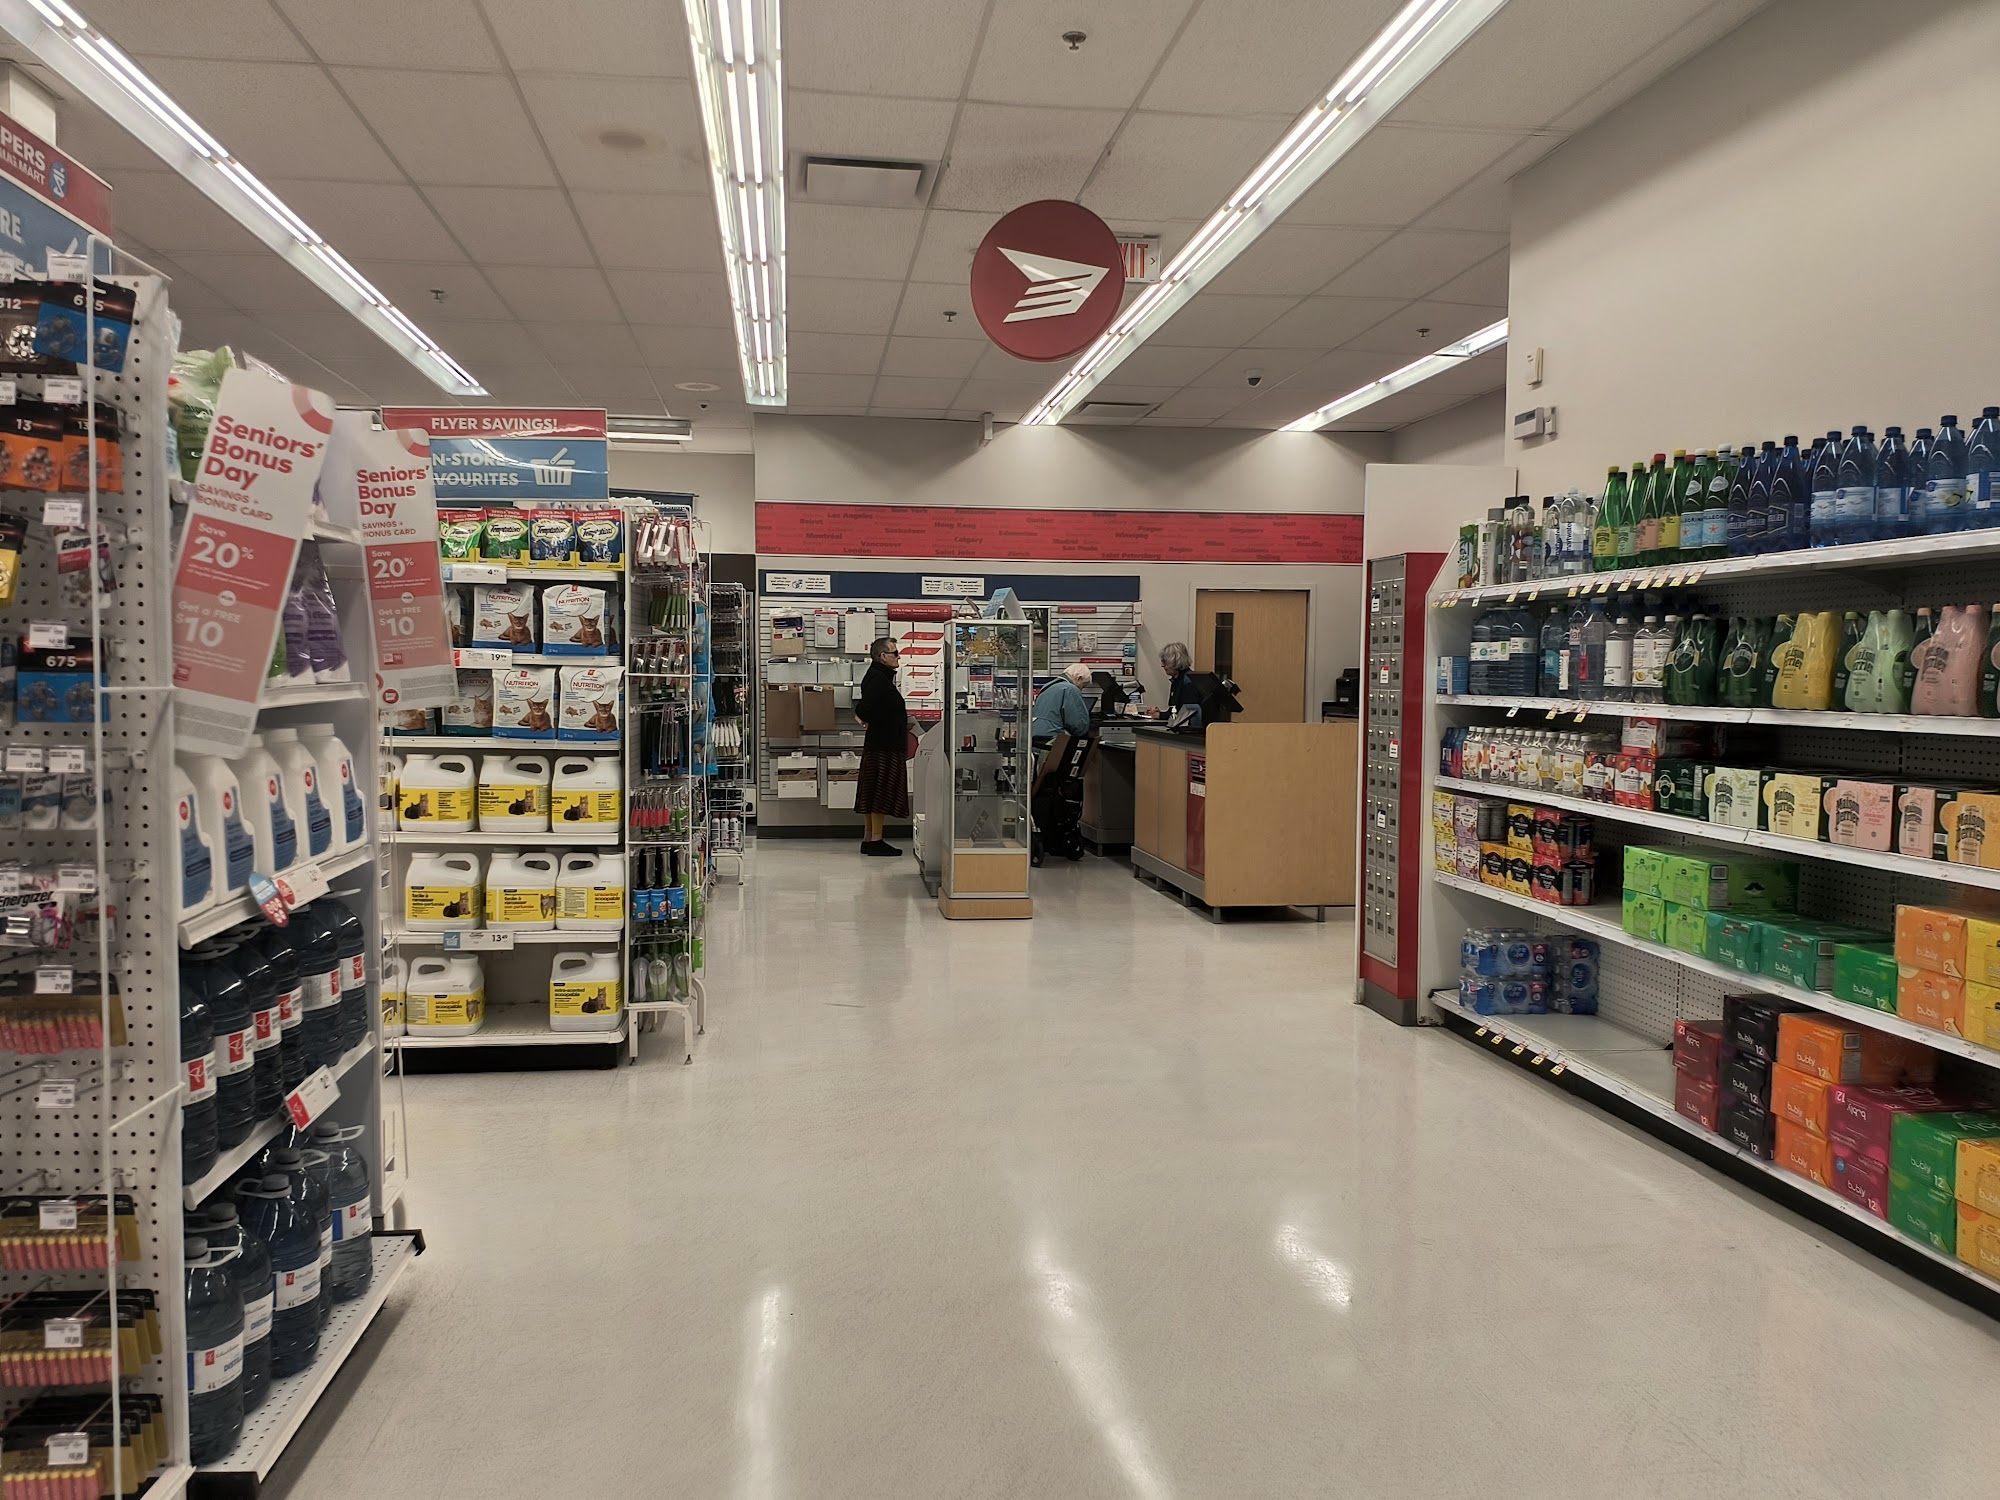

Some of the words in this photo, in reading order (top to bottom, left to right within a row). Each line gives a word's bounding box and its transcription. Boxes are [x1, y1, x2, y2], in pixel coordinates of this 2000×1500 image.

[19, 160, 45, 185] MART
[73, 295, 104, 311] 65
[16, 418, 32, 431] 13
[431, 417, 479, 430] FLYER
[482, 417, 558, 431] SAVINGS!
[215, 415, 324, 458] Seniors'
[209, 435, 293, 474] Bonus
[204, 457, 259, 491] Day
[356, 465, 430, 485] Seniors'
[199, 484, 250, 504] SAVINGS
[358, 485, 416, 500] Bonus
[240, 505, 273, 521] CARD
[360, 501, 396, 519] Day
[199, 523, 227, 538] Save
[362, 521, 397, 529] SAVINGS
[393, 528, 417, 536] CARD
[490, 525, 521, 534] Temptations
[536, 525, 570, 534] Temptation
[954, 536, 983, 544] Calgary
[488, 594, 521, 603] NUTRITION
[558, 597, 590, 605] NUTRITION
[178, 600, 199, 612] Get
[213, 609, 241, 623] FREE
[379, 607, 393, 616] Get
[403, 606, 421, 614] FREE
[175, 613, 224, 647] $10
[379, 616, 415, 636] $10
[46, 655, 77, 667] 675
[573, 681, 605, 689] NUTRITION
[1736, 958, 1744, 968] 12
[1775, 962, 1792, 976] bubly
[1852, 984, 1874, 998] bubly
[1876, 997, 1886, 1009] 12
[1737, 1032, 1754, 1046] bubly
[1755, 1044, 1764, 1056] 12
[1797, 1052, 1816, 1067] bubly
[1818, 1067, 1827, 1078] 12
[1733, 1078, 1748, 1092] bubly
[1750, 1093, 1758, 1104] 12
[1787, 1103, 1803, 1117] bubly
[1701, 1115, 1708, 1126] 12
[1805, 1118, 1813, 1129] 12
[1734, 1127, 1749, 1142] bubly
[1751, 1143, 1759, 1154] 12
[1791, 1153, 1808, 1168] bubly
[1910, 1157, 1931, 1174] bubly
[1810, 1169, 1818, 1180] 12
[1933, 1175, 1943, 1188] 12
[1847, 1180, 1866, 1197] bubly
[1867, 1198, 1877, 1210] 12
[1907, 1214, 1928, 1230] bubly
[1929, 1231, 1939, 1244] 12
